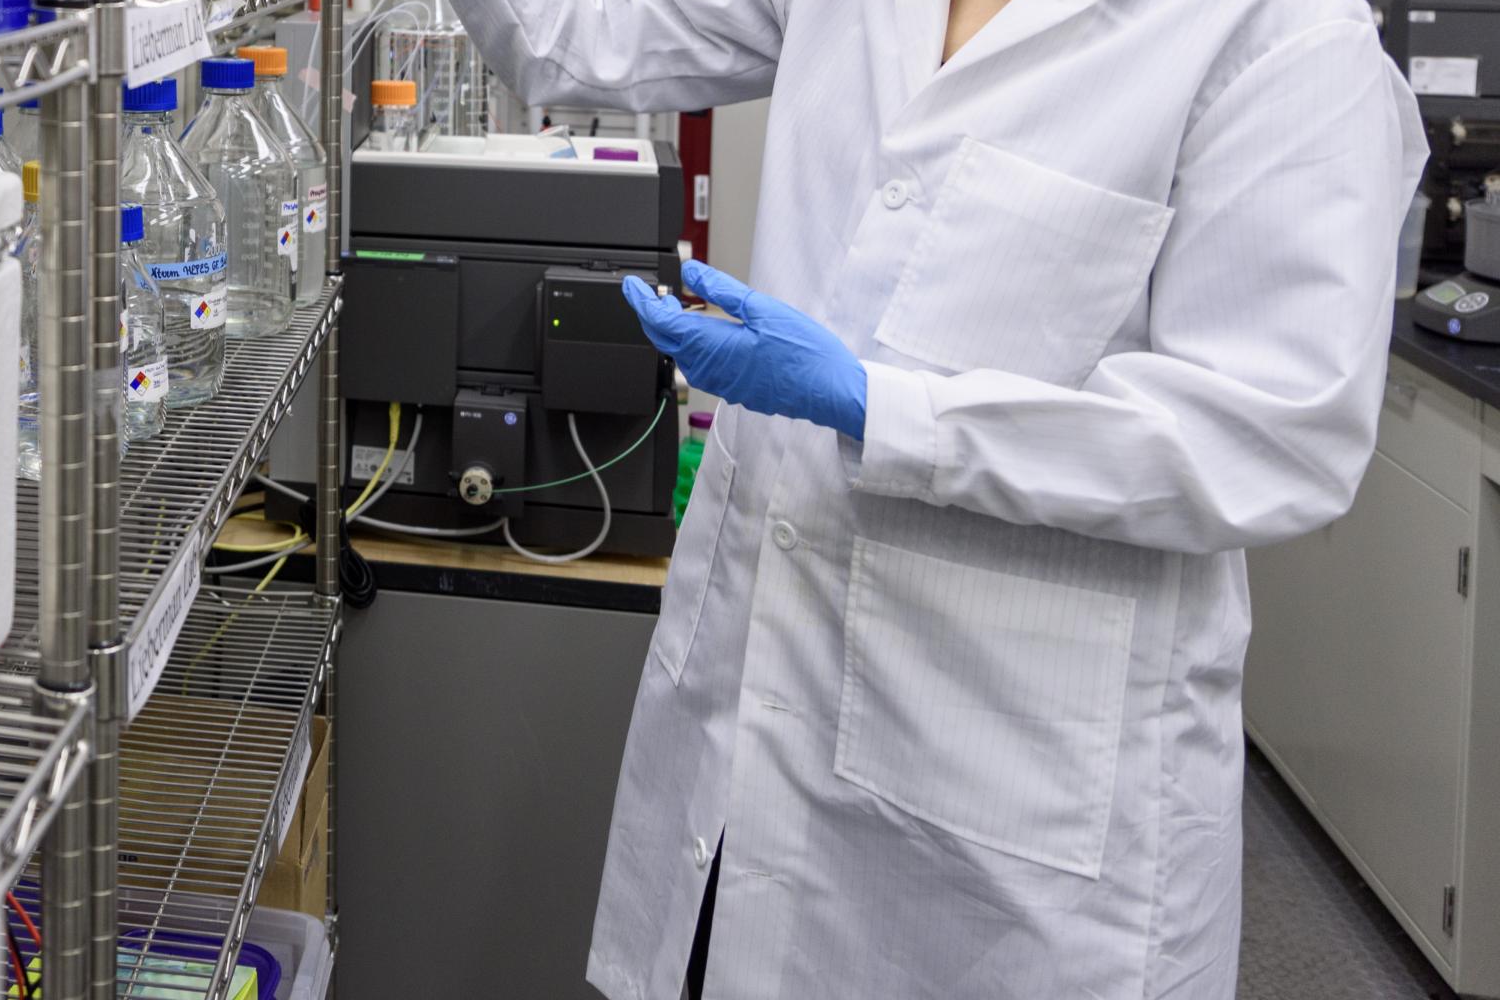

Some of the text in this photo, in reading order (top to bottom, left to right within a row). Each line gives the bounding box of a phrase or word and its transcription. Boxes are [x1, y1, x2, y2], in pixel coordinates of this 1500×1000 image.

[131, 21, 188, 69] Lieberman
[183, 262, 210, 276] HEPES
[131, 584, 183, 700] Lieberman
